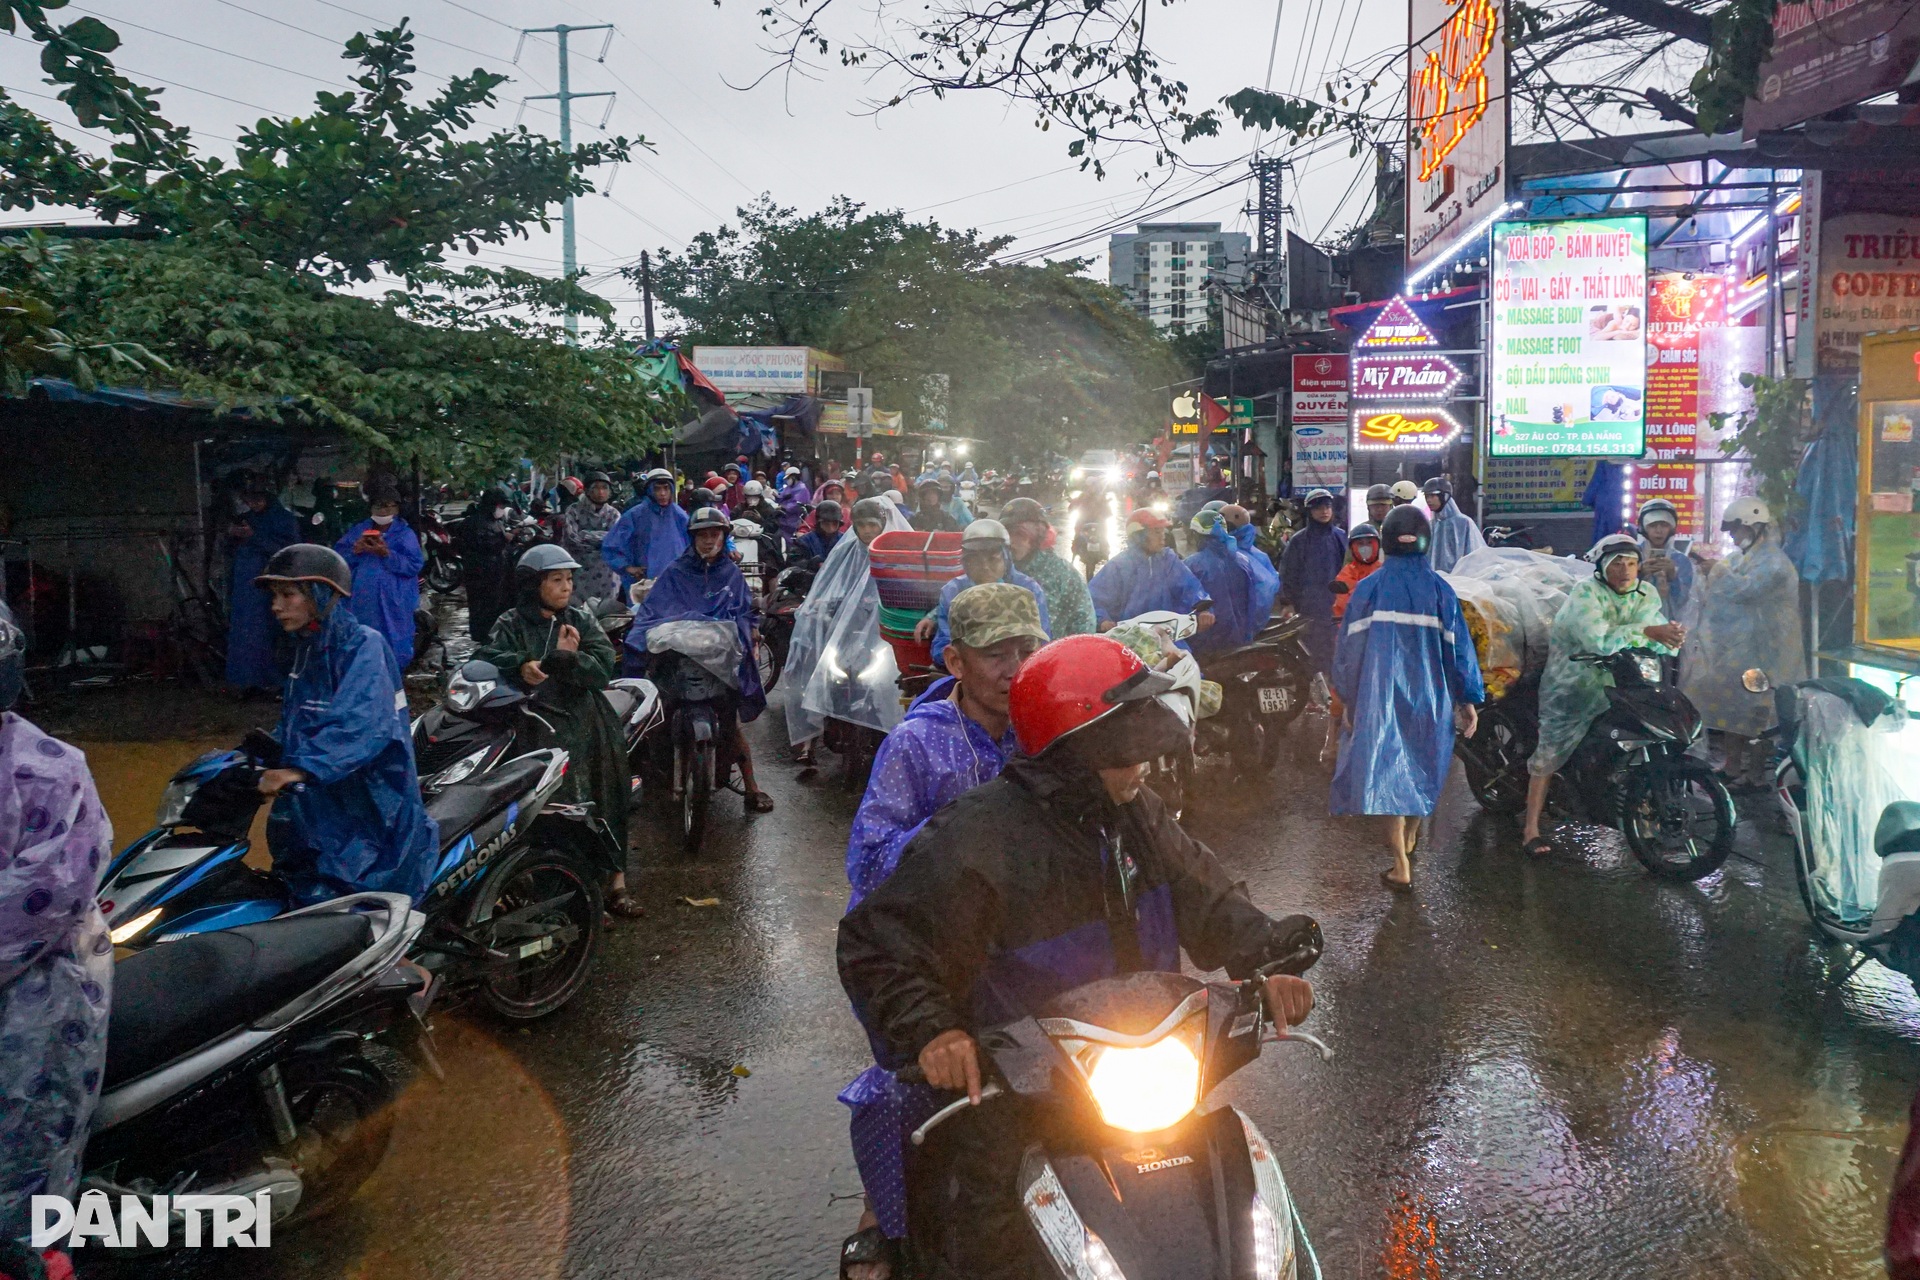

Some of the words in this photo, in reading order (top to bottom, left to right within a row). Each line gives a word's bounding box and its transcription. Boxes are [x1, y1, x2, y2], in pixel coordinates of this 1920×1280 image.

[1534, 231, 1555, 260] BÓP
[1567, 226, 1592, 258] BẤM
[1596, 228, 1632, 262] HUYỆT
[1496, 270, 1510, 301] CỔ
[1522, 278, 1538, 300] VAI
[1550, 272, 1572, 300] GÁY
[1583, 266, 1610, 299] THẮT
[1614, 272, 1644, 298] LƯNG
[1386, 312, 1408, 323] Shop
[1507, 308, 1554, 325] MASSAGE
[1558, 306, 1584, 324] BODY
[1507, 337, 1554, 355] MASSAGE
[1557, 336, 1582, 354] FOOT
[1660, 348, 1681, 363] CHĂM
[1682, 346, 1697, 363] SÓC
[1300, 379, 1319, 388] điện
[1320, 379, 1346, 388] quang
[1361, 367, 1389, 390] Mỹ
[1391, 363, 1448, 386] Phẩm
[1506, 364, 1523, 388] GỘI
[1549, 364, 1582, 384] DƯỠNG
[1586, 366, 1611, 384] SINH
[1506, 398, 1528, 414] NAIL
[1172, 422, 1182, 434] ÉP
[1182, 422, 1199, 434] KÍNH
[1360, 413, 1439, 442] Spa
[1532, 432, 1545, 441] ÂU
[1546, 432, 1560, 441] CƠ
[1582, 431, 1596, 440] ĐÀ
[1646, 424, 1662, 435] AX
[1666, 422, 1696, 435] LÔNG
[1500, 443, 1548, 454] Hotline:
[1552, 443, 1636, 454] 0784.154.313
[1668, 477, 1688, 492] TRỊ
[1263, 688, 1284, 700] 92-E1
[436, 822, 517, 897] PETRONAS
[1138, 1155, 1194, 1174] HONDA
